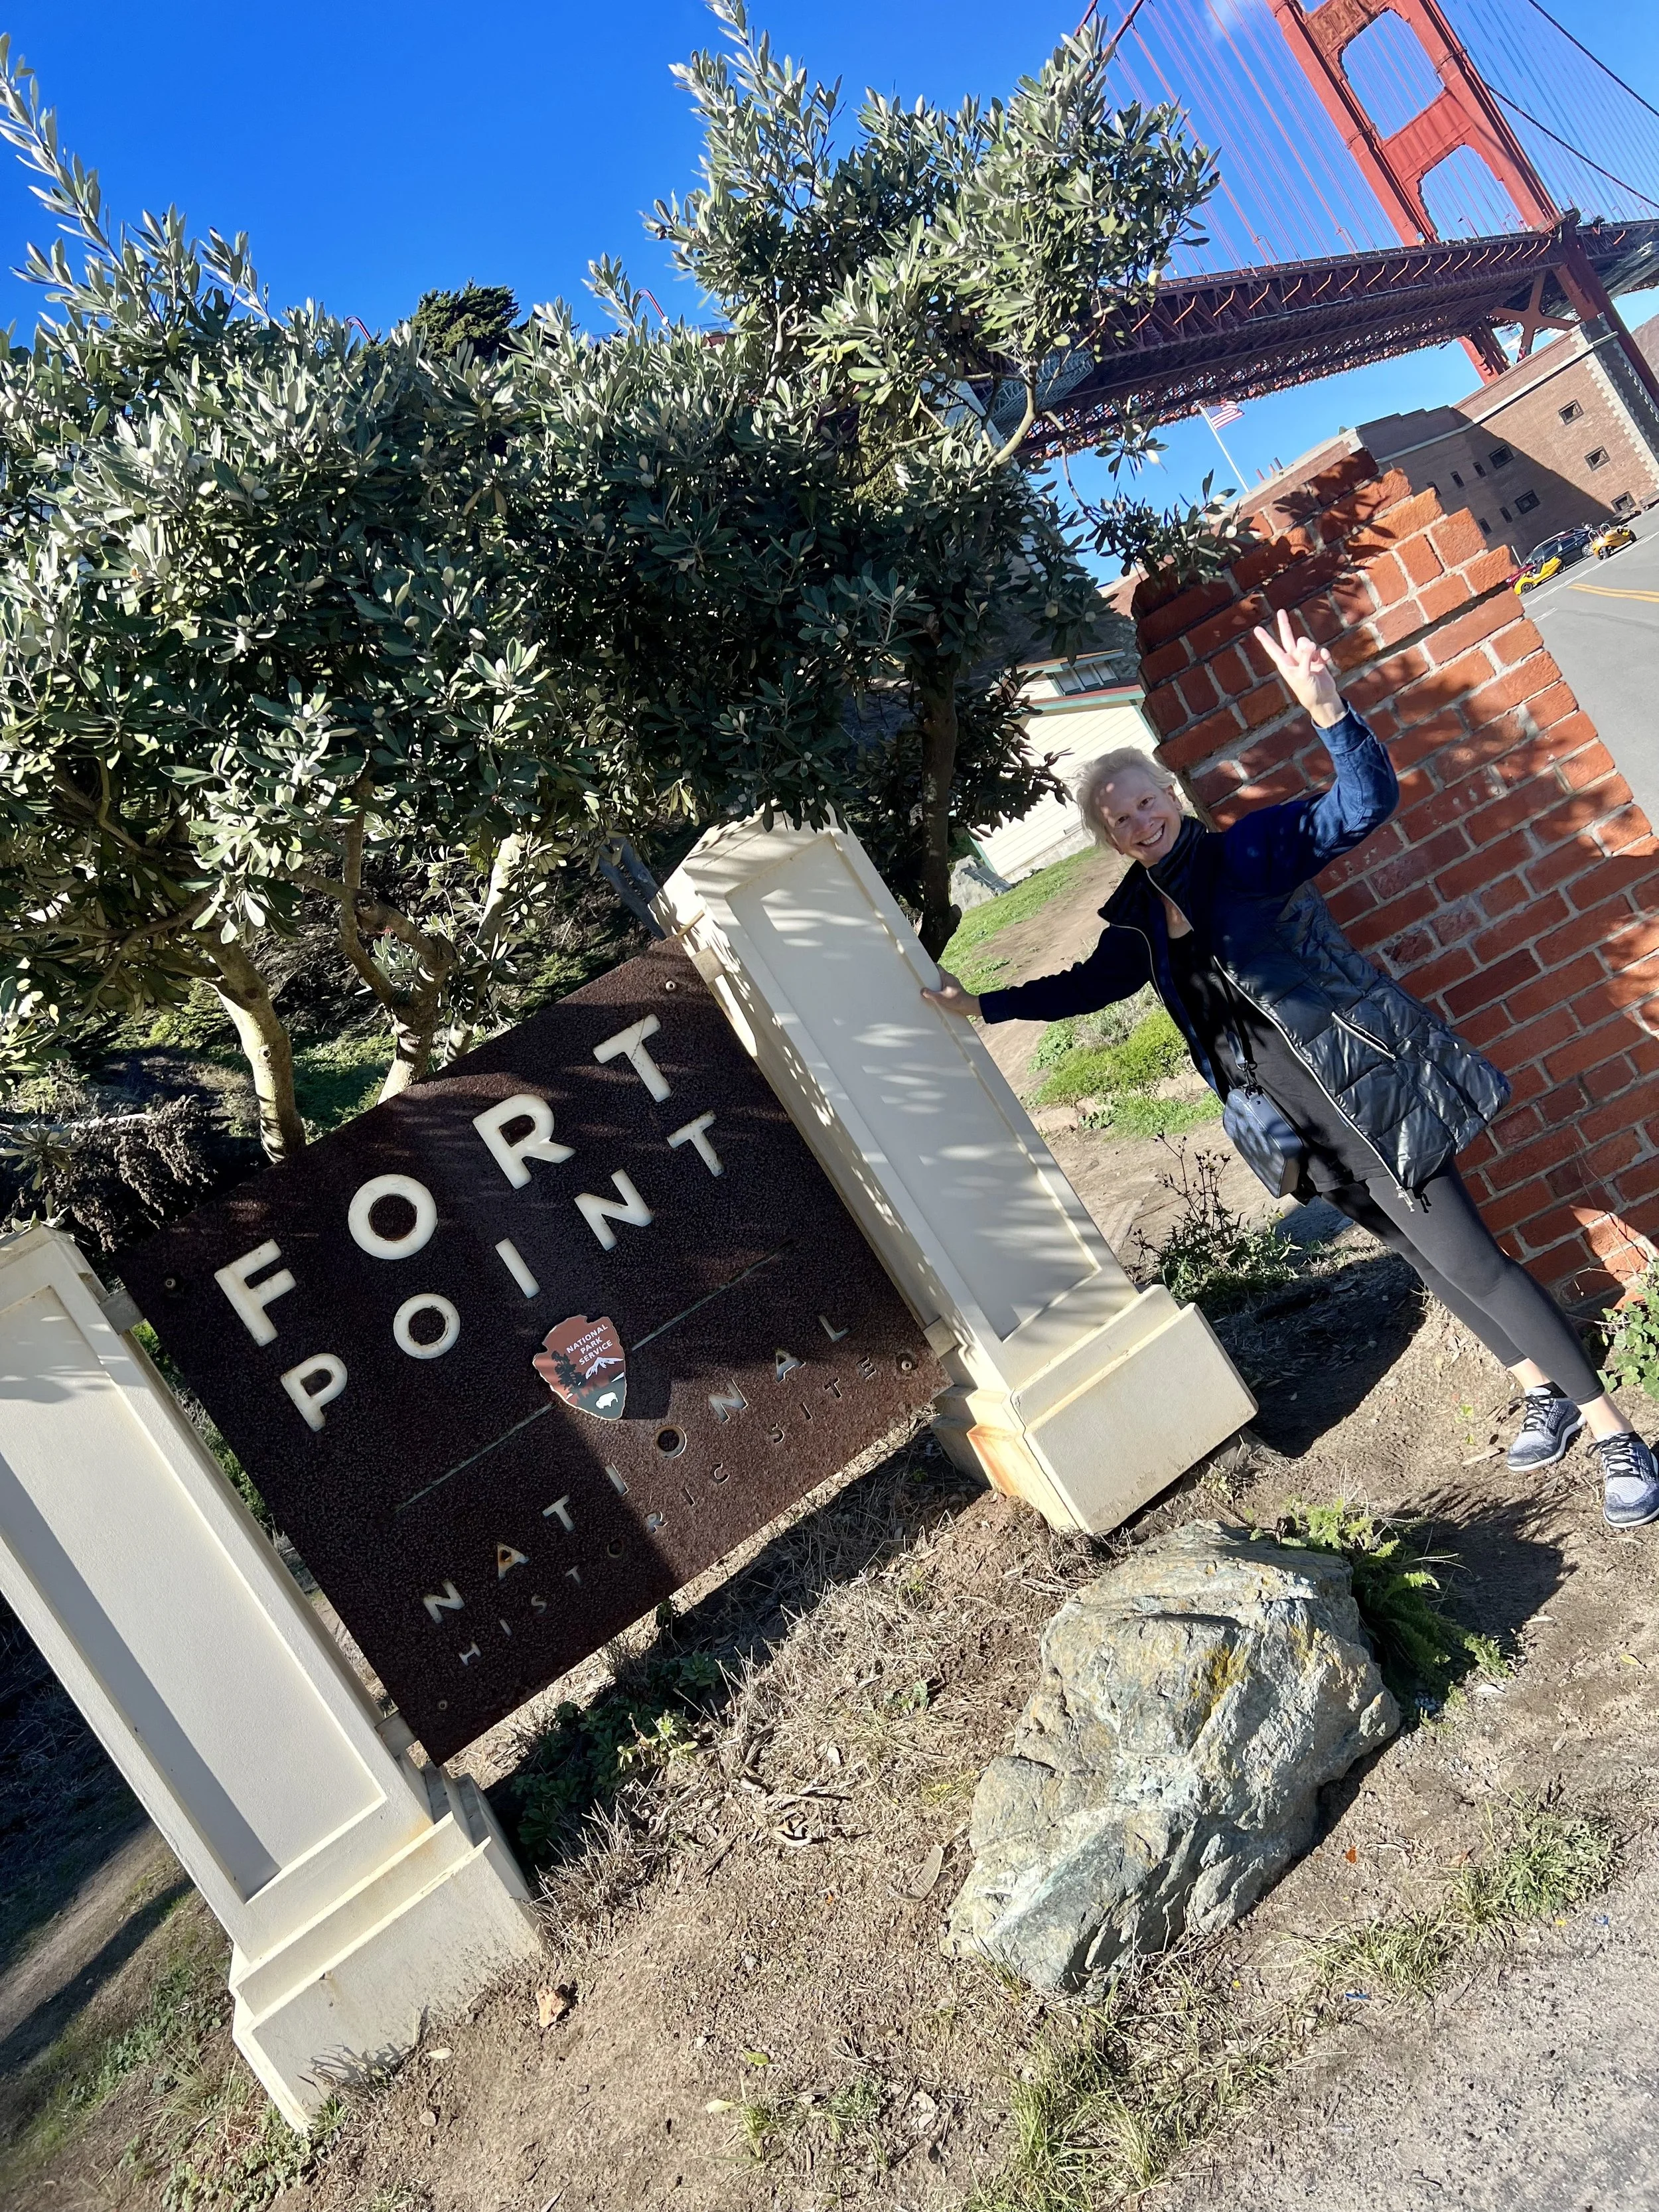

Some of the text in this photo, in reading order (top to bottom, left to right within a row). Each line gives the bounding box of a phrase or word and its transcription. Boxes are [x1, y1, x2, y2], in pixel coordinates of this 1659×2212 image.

[214, 1013, 672, 1347] FORT
[280, 1110, 725, 1432] POINT
[423, 1314, 851, 1624] NATIONAL
[566, 1325, 608, 1353] NATIONAL
[579, 1340, 613, 1365] SERVICE
[580, 1337, 603, 1354] PARK
[459, 1356, 877, 1666] HISTORIC SITE
